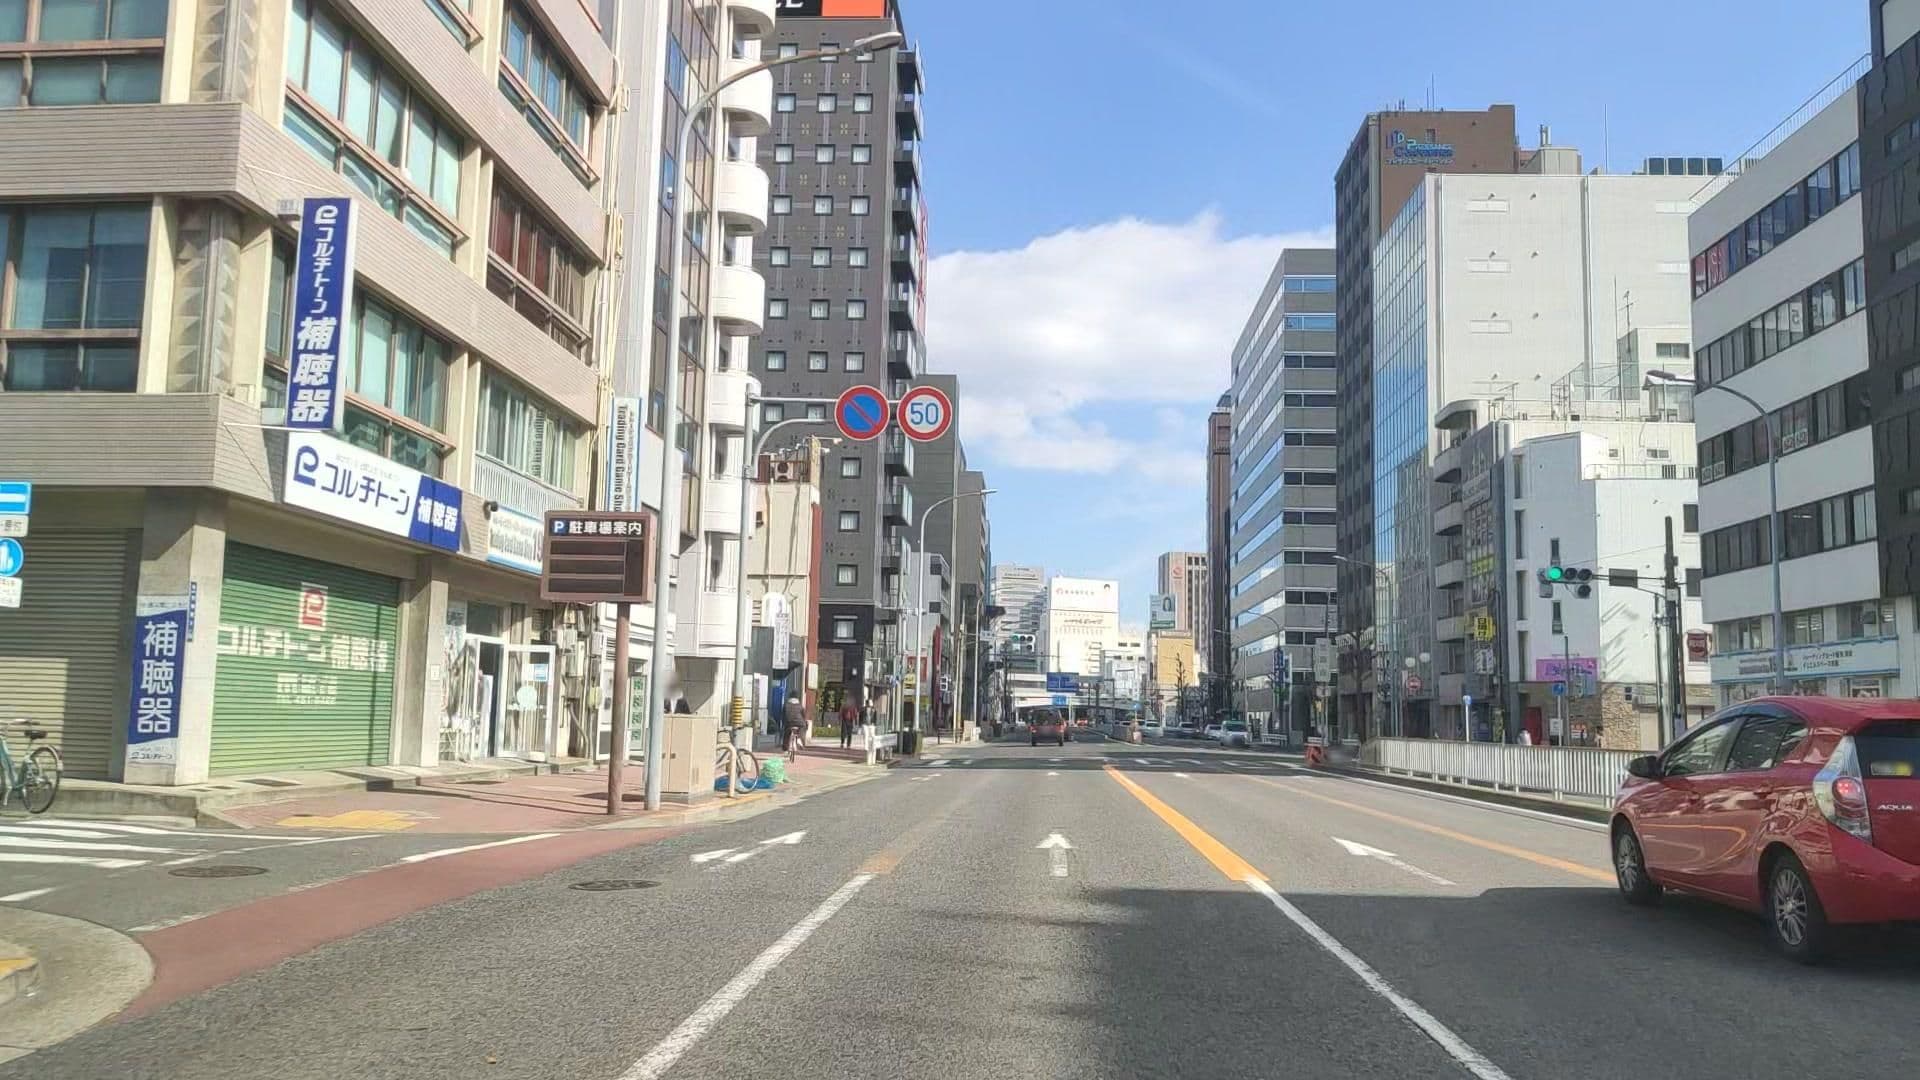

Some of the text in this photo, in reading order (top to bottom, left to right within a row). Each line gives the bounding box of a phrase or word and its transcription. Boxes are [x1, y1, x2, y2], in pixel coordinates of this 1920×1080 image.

[291, 316, 338, 422] 補聴器
[909, 402, 939, 426] 50
[320, 462, 410, 516] コルチトーン
[568, 520, 643, 535] 駐車場案内
[137, 620, 179, 734] 補聴器
